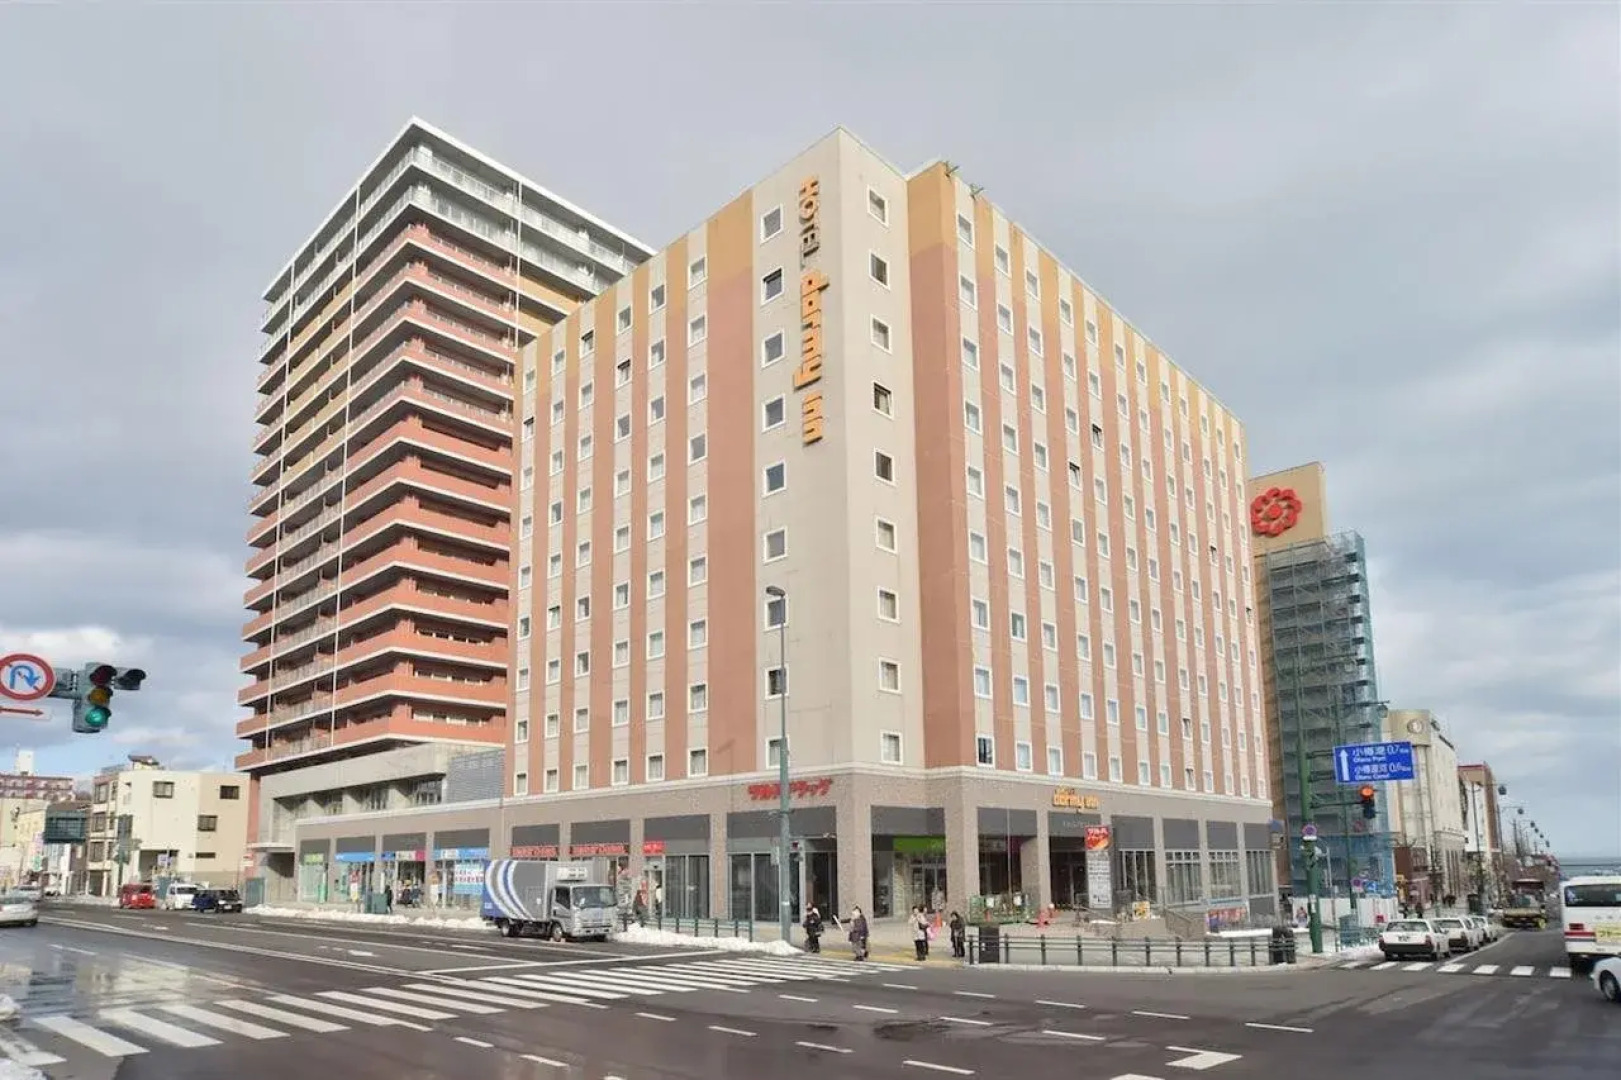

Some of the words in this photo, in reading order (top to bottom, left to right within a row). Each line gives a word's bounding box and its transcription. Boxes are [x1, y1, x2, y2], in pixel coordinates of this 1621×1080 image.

[799, 176, 820, 267] HOTEL
[793, 270, 830, 393] dormy
[802, 391, 823, 448] inn
